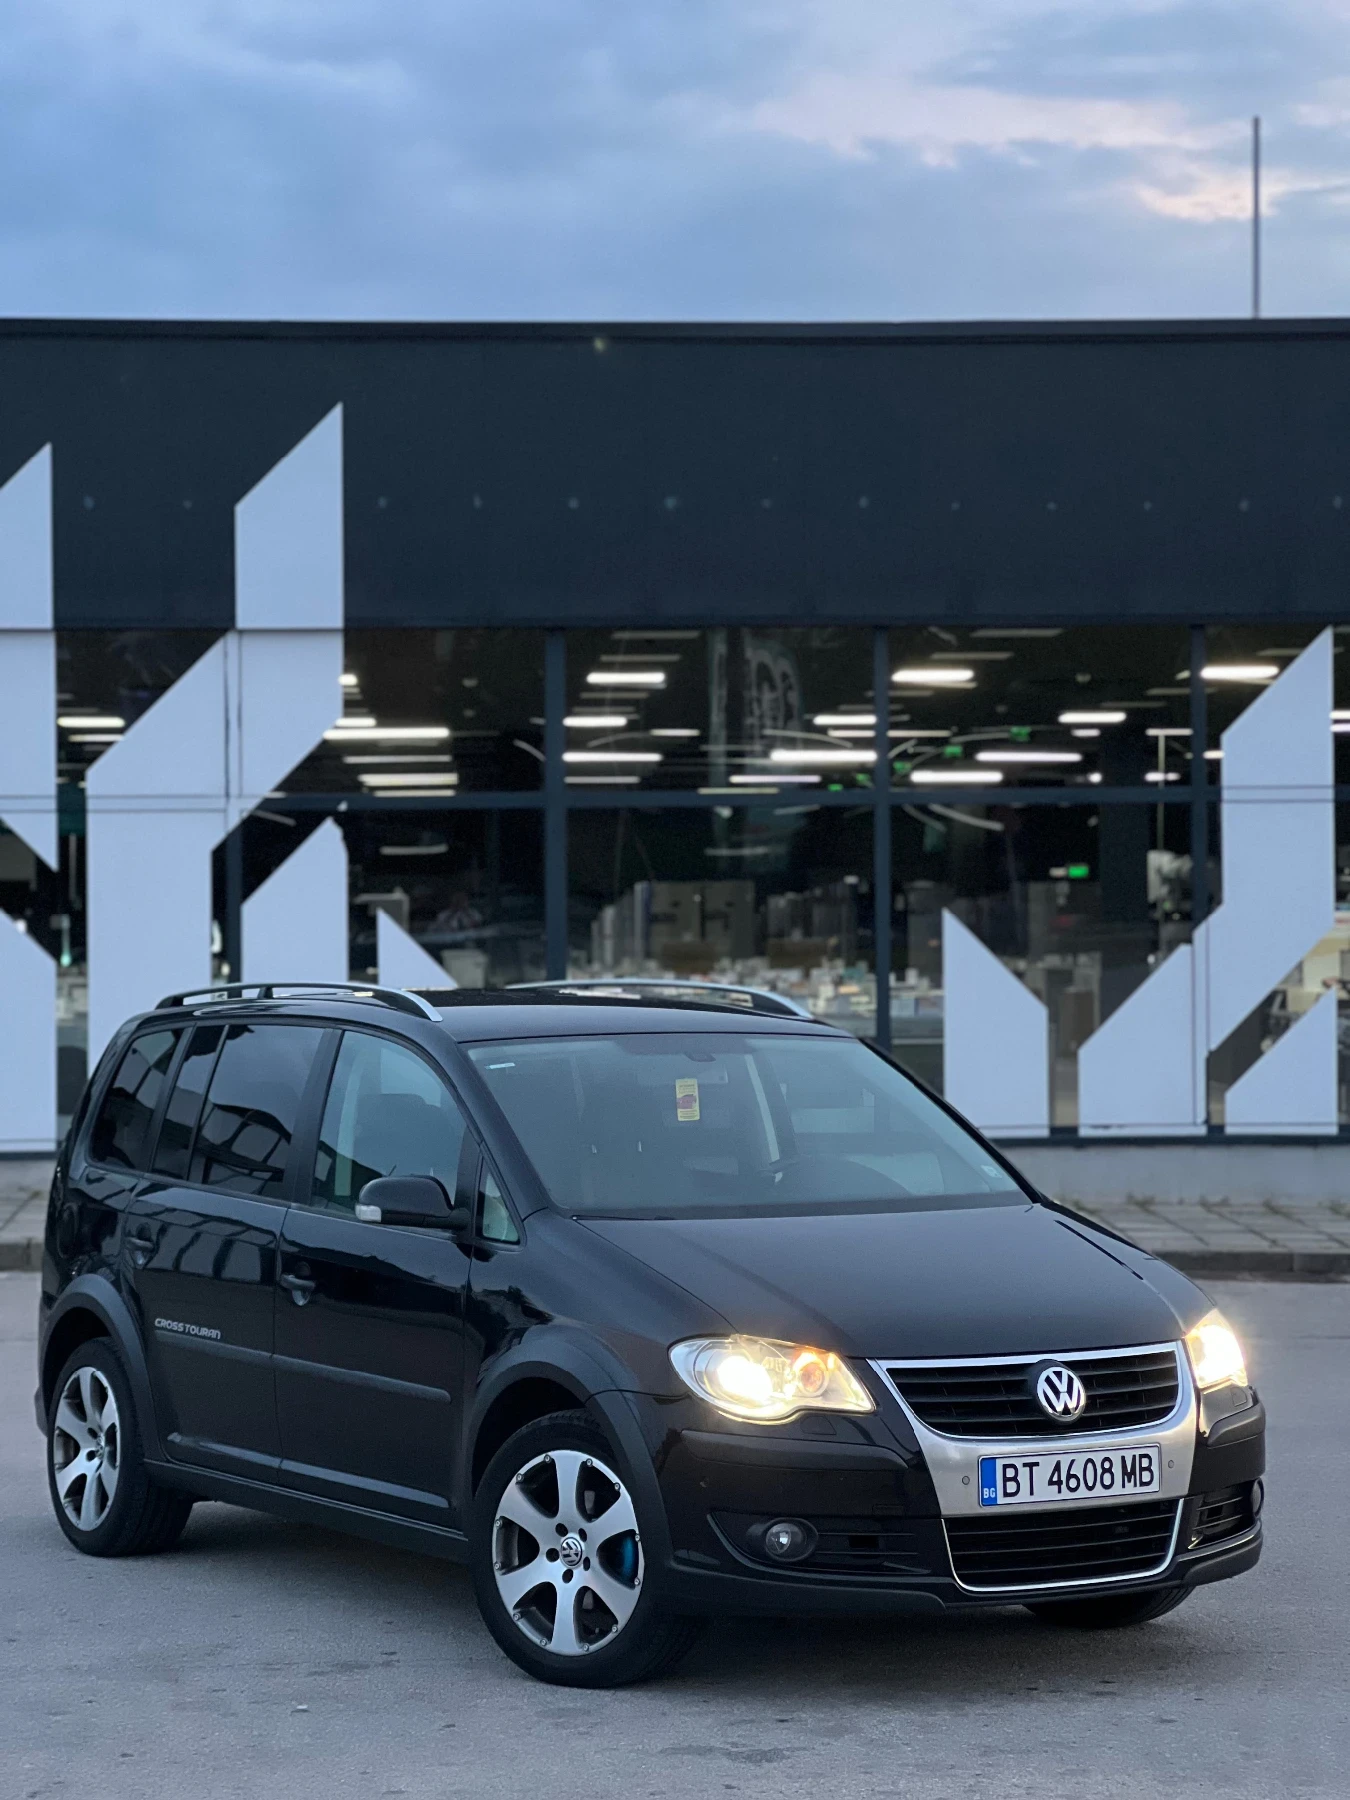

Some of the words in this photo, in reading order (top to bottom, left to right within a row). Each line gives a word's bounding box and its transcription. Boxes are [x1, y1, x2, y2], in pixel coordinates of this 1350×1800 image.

[1036, 1366, 1086, 1421] VW
[983, 1487, 996, 1499] BG
[1002, 1461, 1040, 1498] BT
[1047, 1456, 1115, 1494] 4608
[1120, 1453, 1155, 1489] MB
